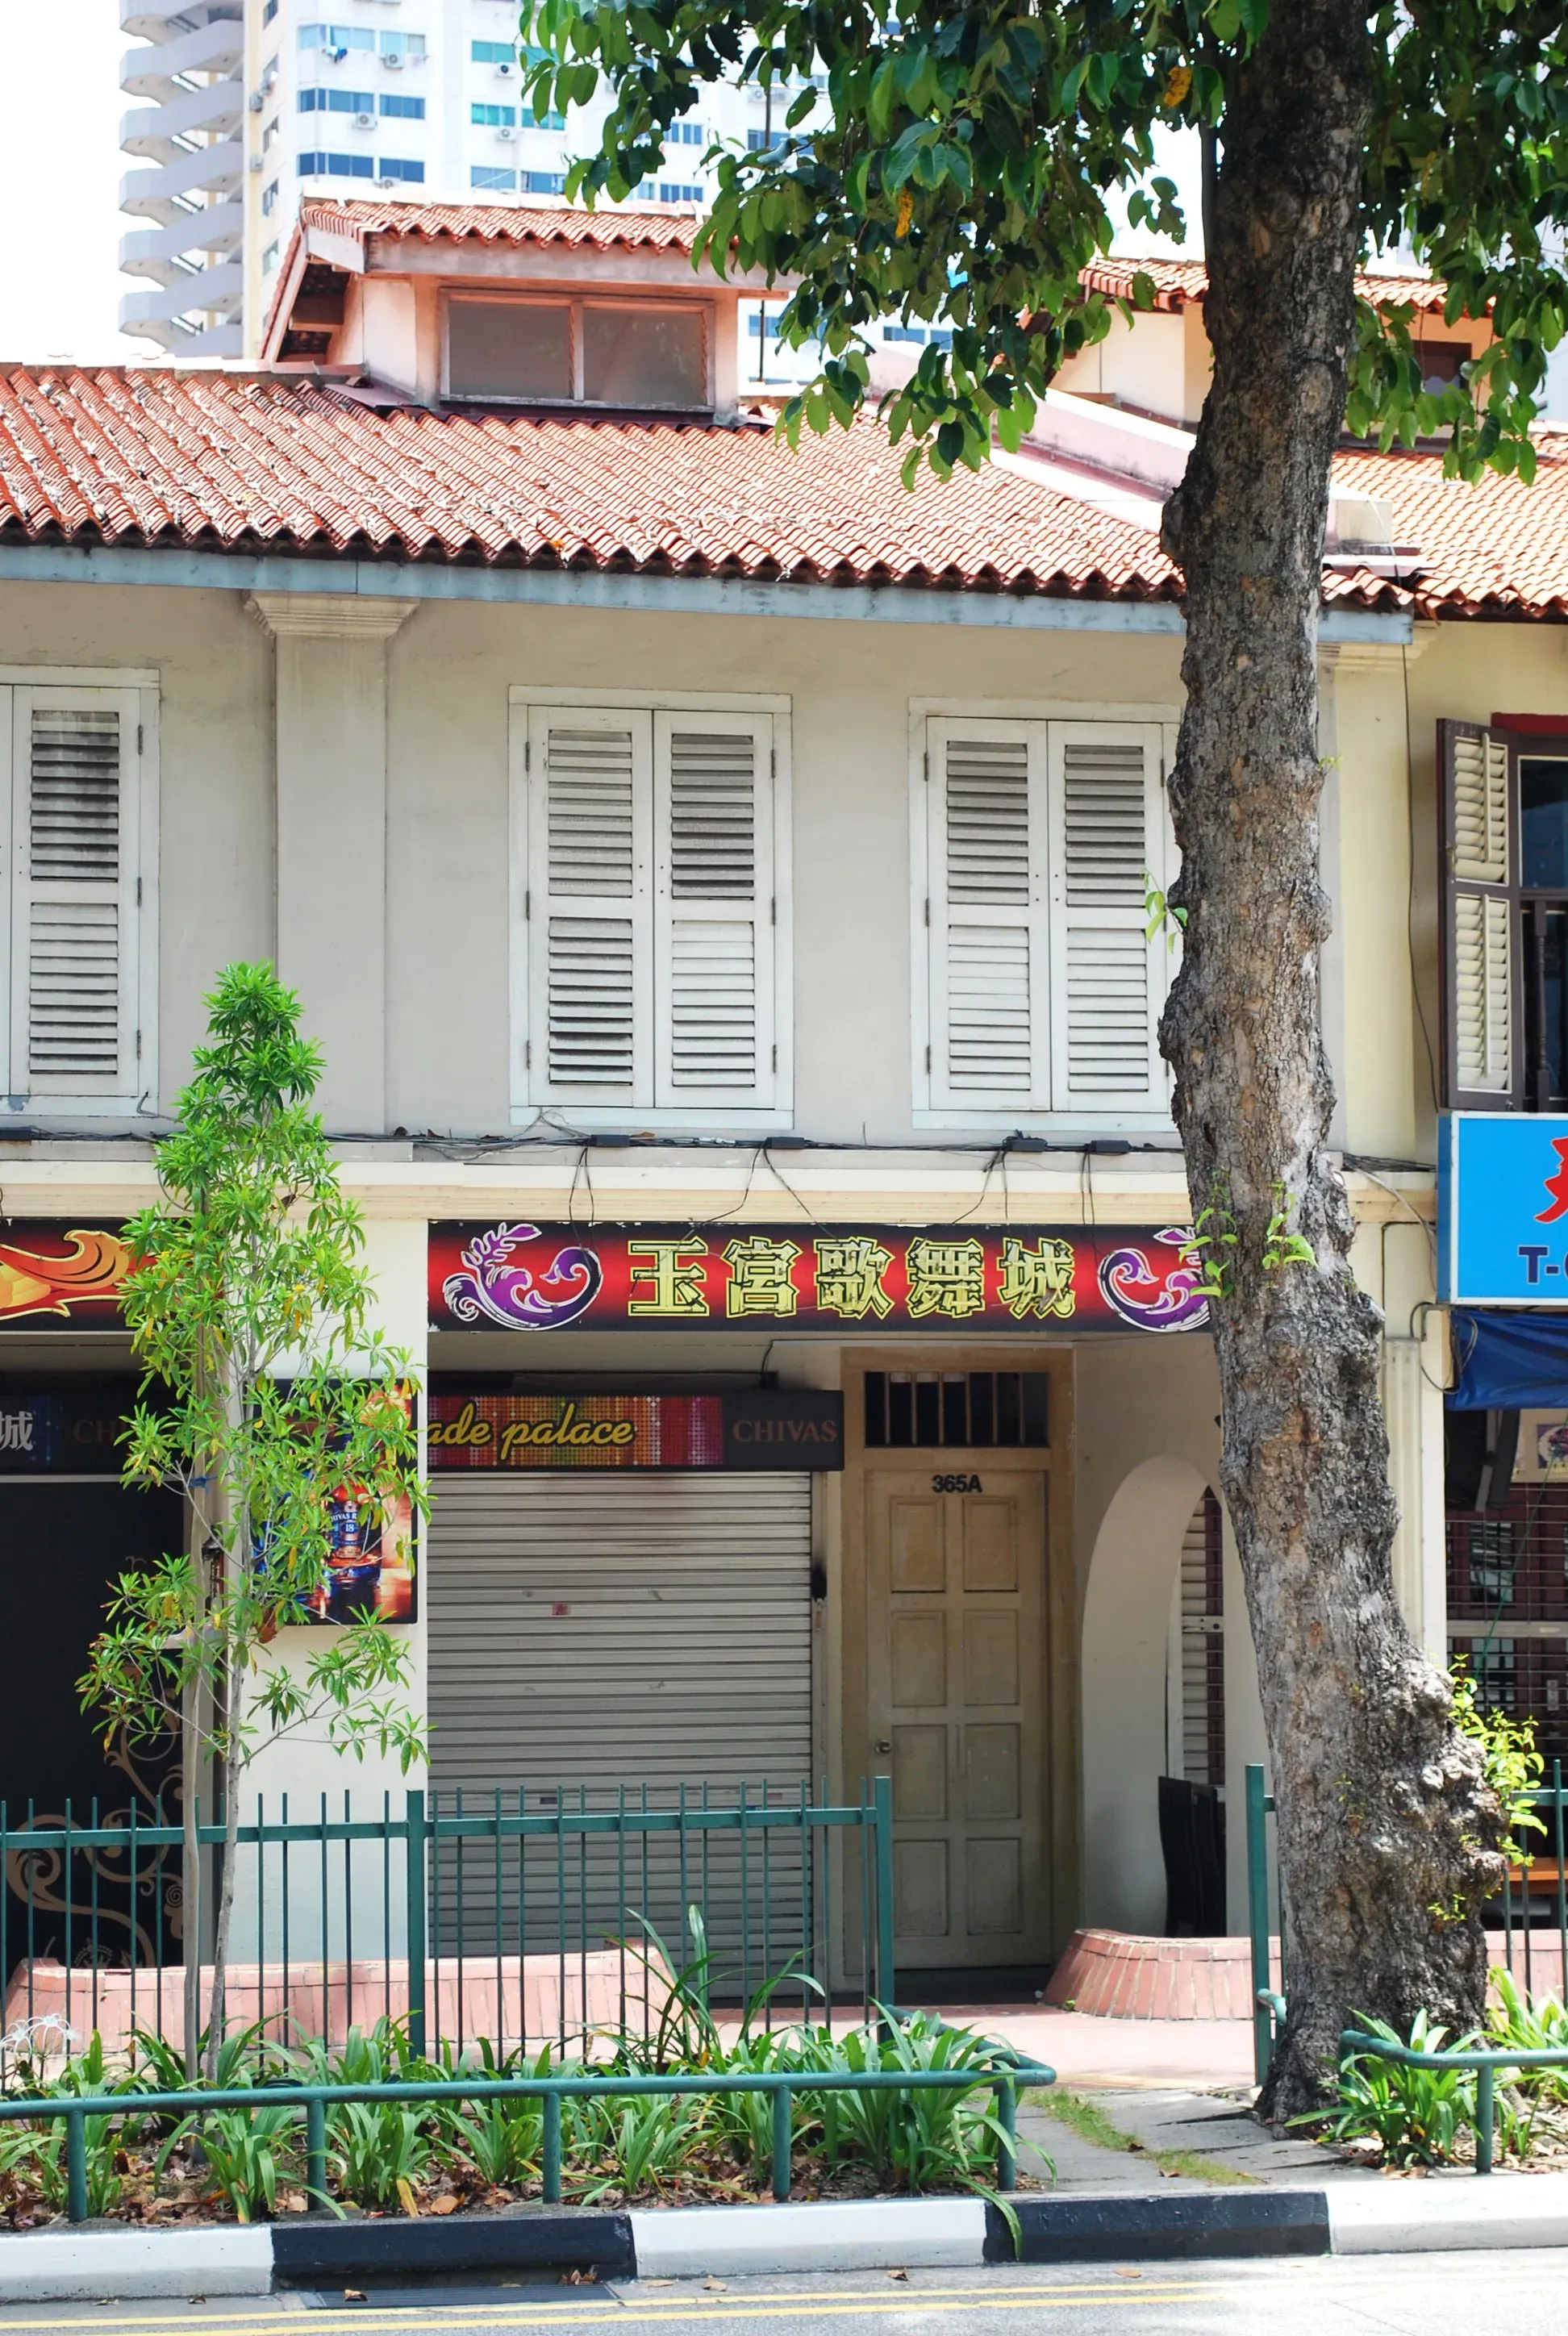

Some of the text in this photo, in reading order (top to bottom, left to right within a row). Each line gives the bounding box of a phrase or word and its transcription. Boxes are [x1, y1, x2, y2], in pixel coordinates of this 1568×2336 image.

[1517, 1245, 1568, 1285] T-
[427, 1402, 634, 1461] ade palace
[732, 1420, 838, 1443] CHIVAS
[932, 1474, 983, 1493] 365A
[331, 1512, 351, 1522] HIVAS
[345, 1524, 355, 1533] 18
